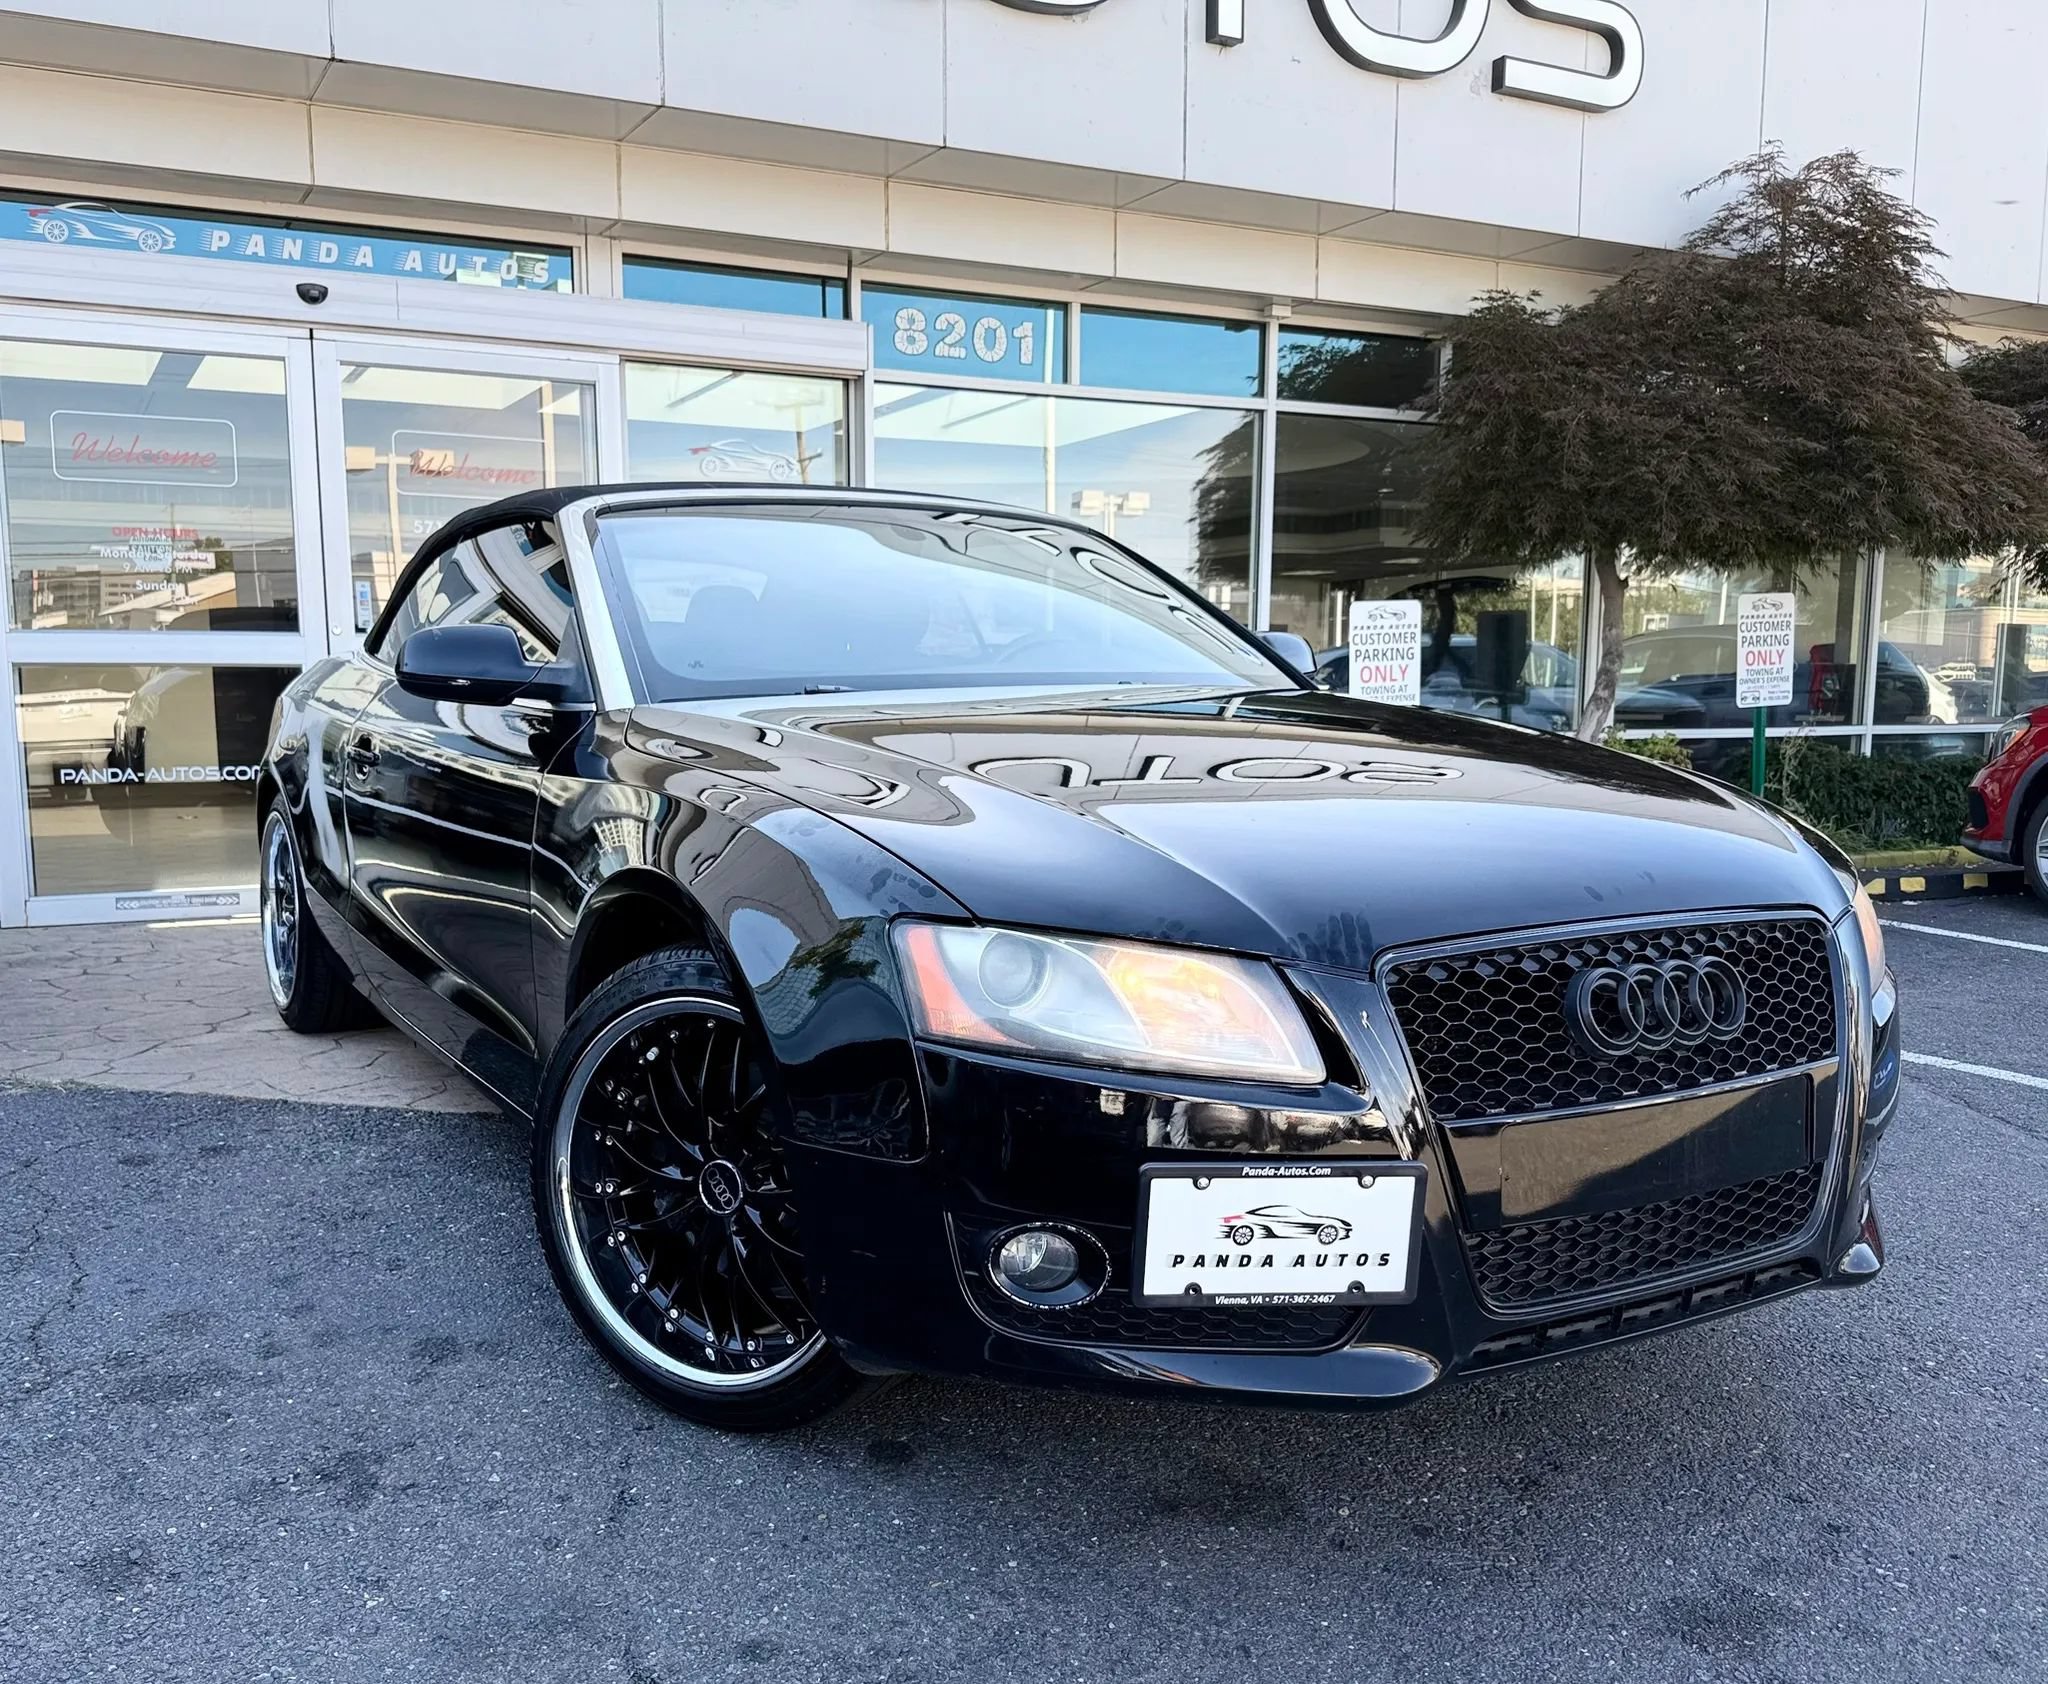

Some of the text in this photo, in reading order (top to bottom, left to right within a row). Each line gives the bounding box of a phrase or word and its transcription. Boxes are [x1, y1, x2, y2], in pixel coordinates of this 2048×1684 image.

[207, 228, 550, 284] PANDA AUTOS
[893, 306, 1034, 365] 8201
[71, 431, 219, 471] Welcome
[409, 449, 538, 485] Welcome
[100, 547, 213, 563] Monday-Saturday
[135, 579, 182, 593] Sunday
[1739, 620, 1792, 633] CUSTOMER
[1352, 632, 1417, 646] CUSTOMER
[1741, 634, 1790, 648] PARKING
[1354, 647, 1415, 663] PARKING
[1745, 649, 1785, 667] ONLY
[1359, 664, 1409, 684] ONLY
[1745, 667, 1784, 677] TOWING AT
[1739, 675, 1790, 685] OWNER'S EXPENSE
[1360, 684, 1409, 696] TOWING AT
[1242, 1165, 1332, 1178] Panda-Autos.Com
[1170, 1252, 1391, 1269] PANDA AUTOS
[1215, 1293, 1336, 1305] Vienna, VA 571-367-2467
